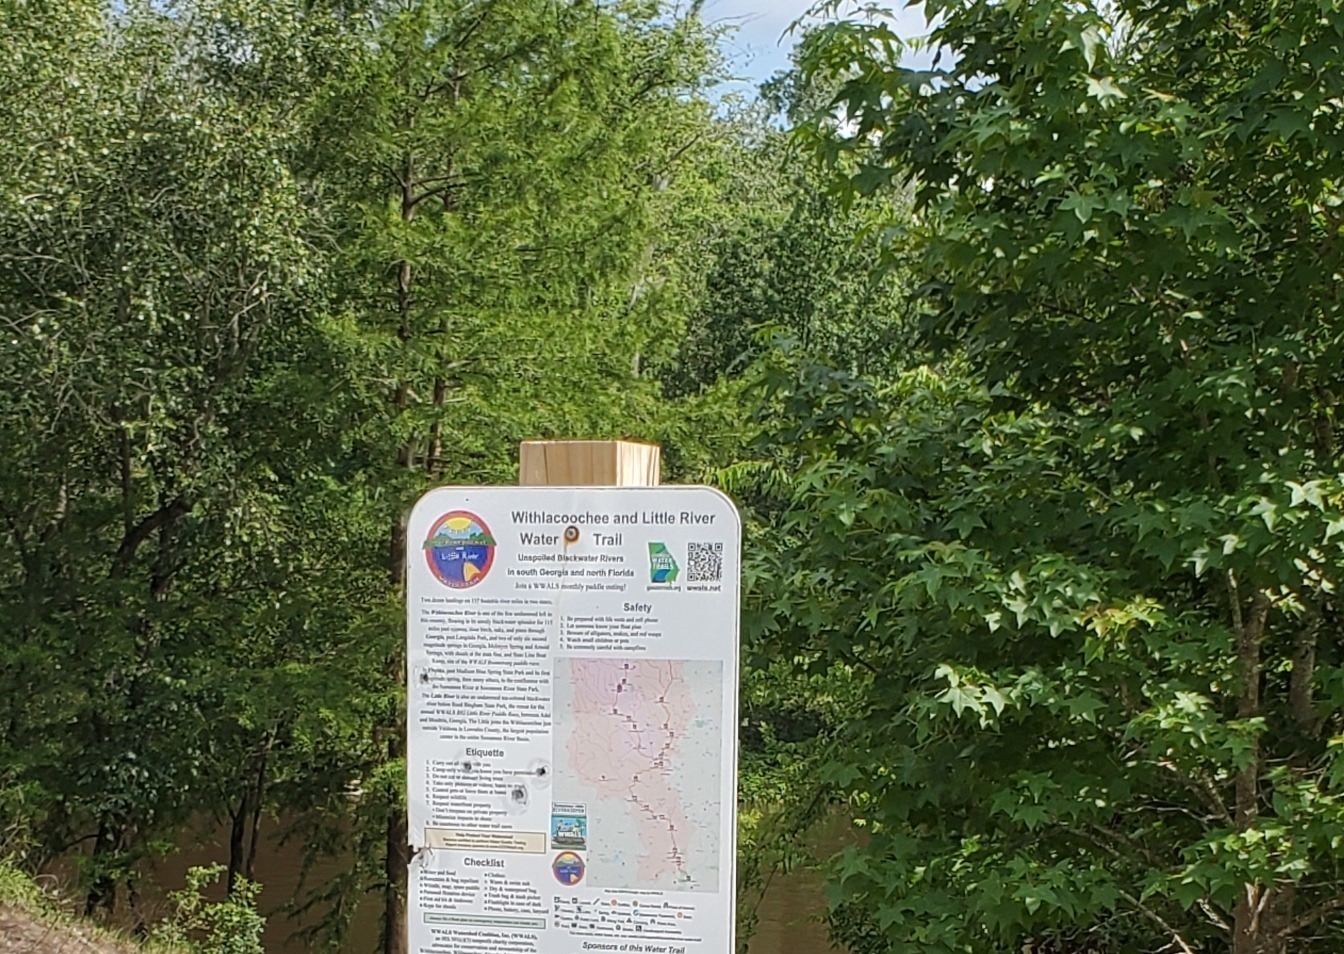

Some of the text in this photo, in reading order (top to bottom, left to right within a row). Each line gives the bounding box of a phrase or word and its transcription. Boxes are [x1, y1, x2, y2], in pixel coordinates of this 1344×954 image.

[512, 511, 716, 525] Withlacoochee and Little River
[520, 532, 623, 546] Water Trail
[518, 554, 624, 563] Unspoiled Blackwater Rivers
[517, 569, 538, 577] south
[540, 568, 569, 578] Georgia
[571, 569, 584, 577] and
[624, 602, 652, 614] Safety
[466, 747, 505, 758] Etiquette
[464, 857, 505, 868] Checklist
[583, 941, 617, 951] Sponsors
[629, 944, 643, 952] this
[645, 945, 667, 953] Water
[669, 946, 685, 954] Trail
